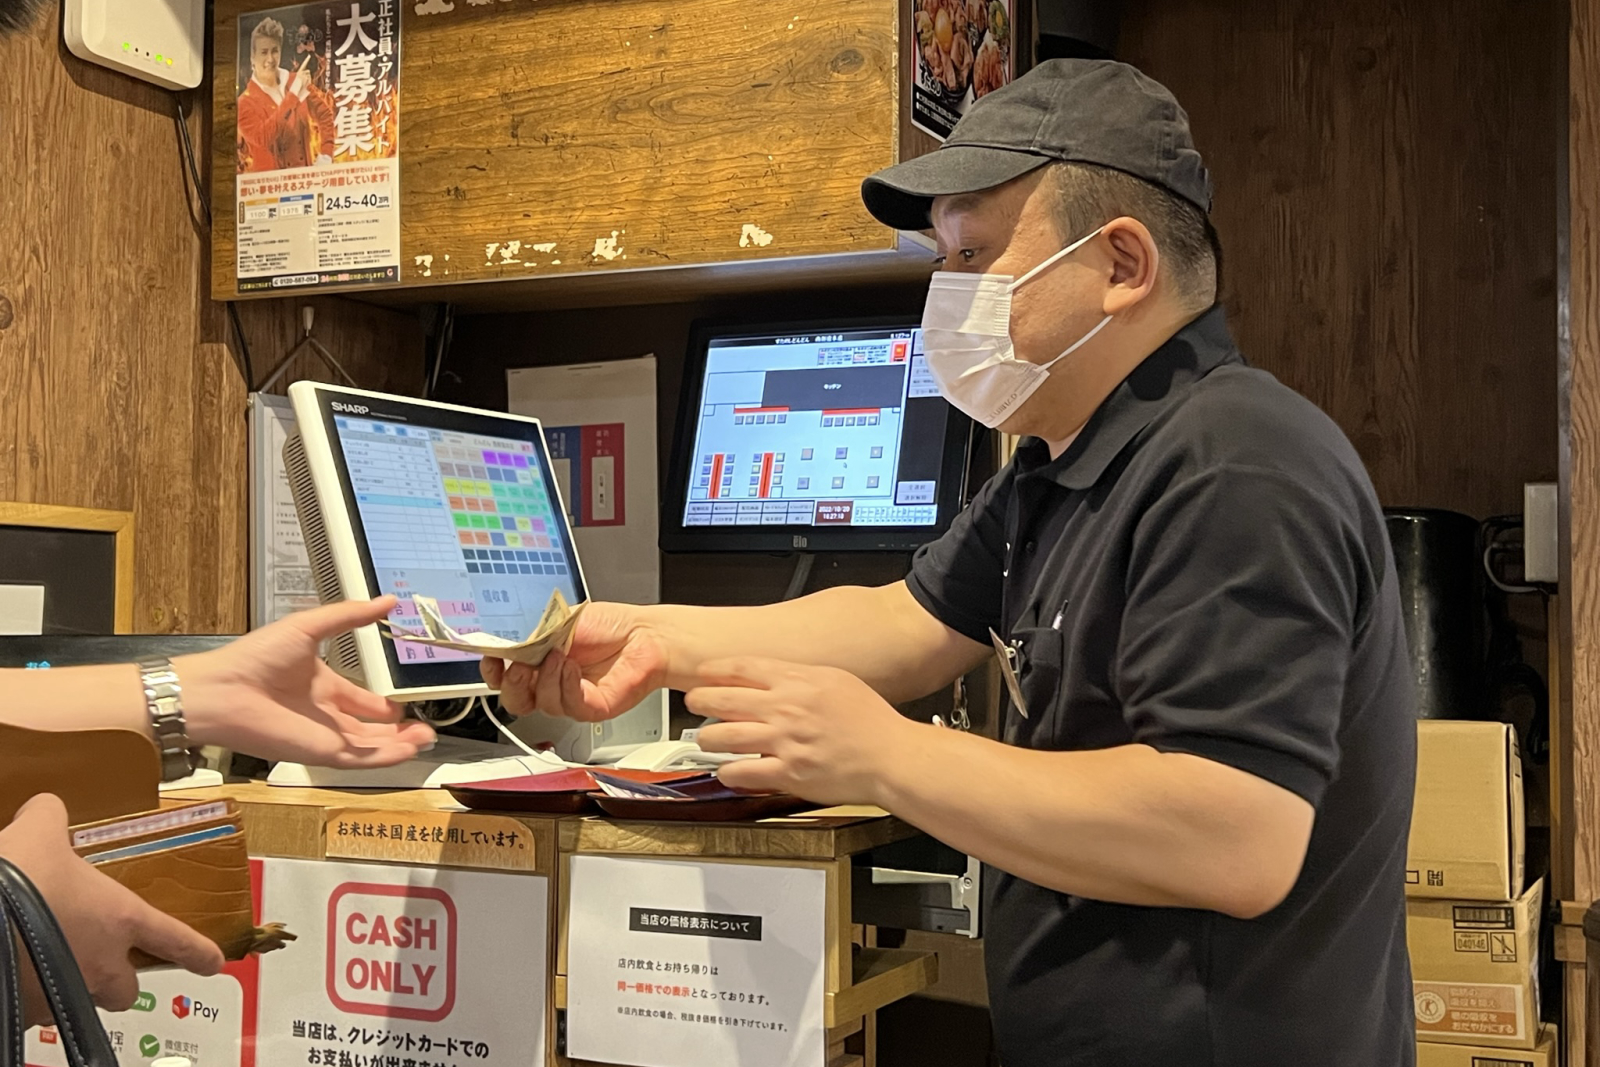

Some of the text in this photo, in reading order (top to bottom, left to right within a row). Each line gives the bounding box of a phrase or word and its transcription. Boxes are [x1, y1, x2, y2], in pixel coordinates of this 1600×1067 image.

[333, 3, 378, 157] 大募集
[331, 401, 369, 415] SHARP
[482, 589, 510, 603] 領収書
[336, 820, 526, 850] お米は米国産を使用しています。
[345, 911, 437, 951] CASH
[640, 913, 750, 934] 当店の価格表示について
[345, 957, 437, 996] ONLY
[617, 957, 719, 976] 店内飲食とお持ち帰りは
[617, 980, 771, 1007] 同一価格での表示となっております。
[193, 1000, 219, 1023] Pay
[292, 1019, 490, 1059] 当店は、クレジットカードでの
[1451, 1021, 1515, 1034] おだやかにする
[165, 1039, 199, 1055] 微信支付
